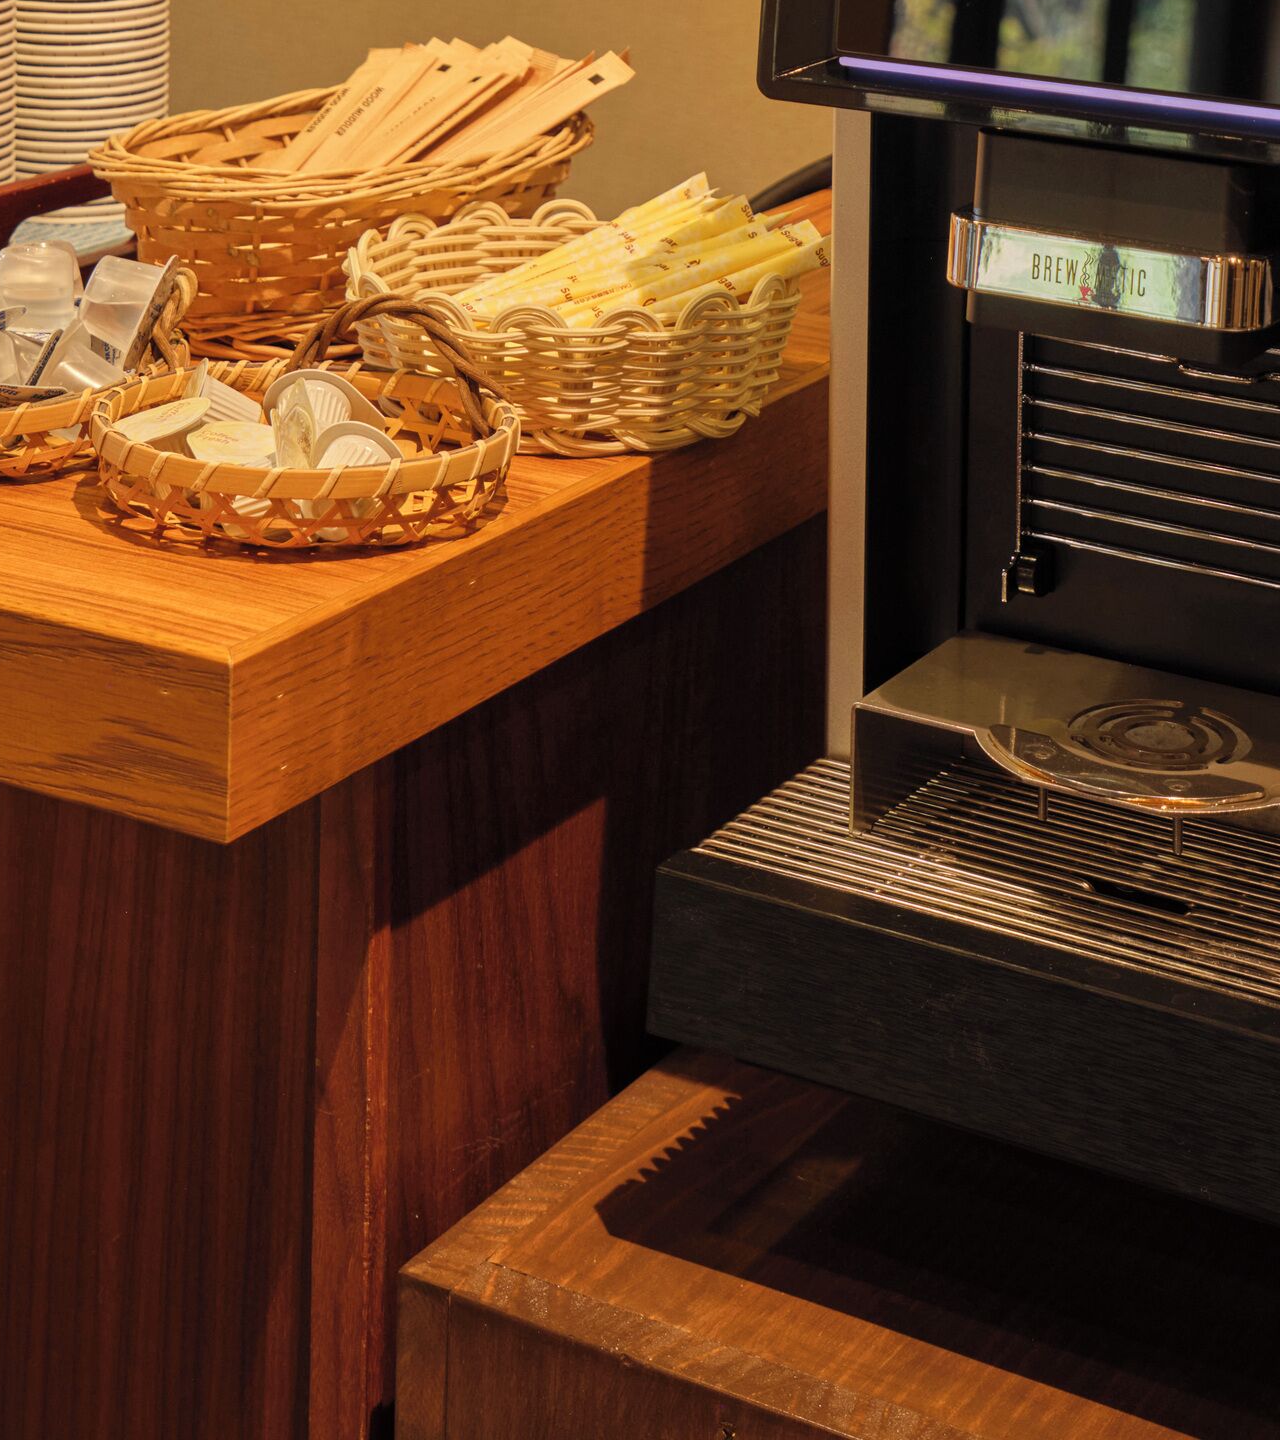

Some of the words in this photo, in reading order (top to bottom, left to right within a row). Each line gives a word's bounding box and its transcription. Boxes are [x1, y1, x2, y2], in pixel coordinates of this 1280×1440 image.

[364, 86, 384, 108] WOOD
[335, 106, 365, 136] MUDDLER
[1031, 253, 1078, 286] BREW
